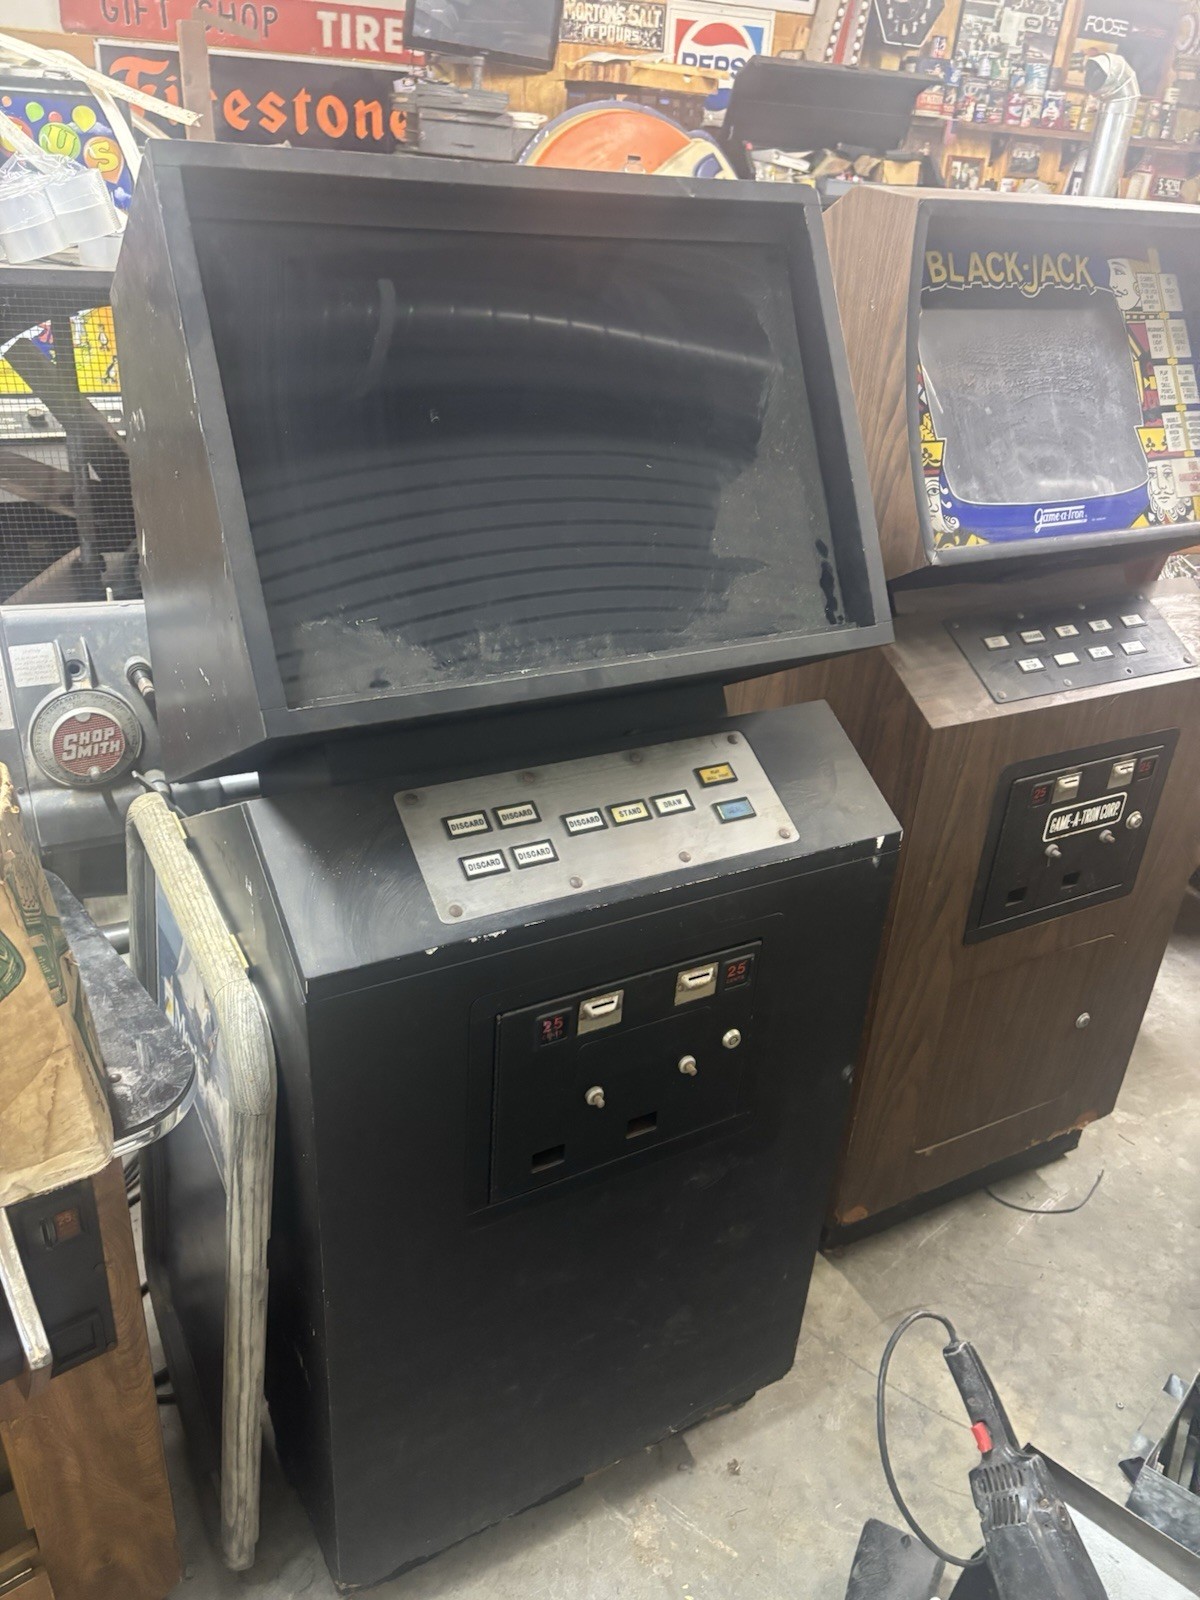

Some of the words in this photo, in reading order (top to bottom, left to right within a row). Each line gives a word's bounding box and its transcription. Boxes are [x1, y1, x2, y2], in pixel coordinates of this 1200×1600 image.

[316, 10, 424, 56] TIRE
[1084, 15, 1129, 37] FOOSE
[682, 52, 748, 80] PEPS
[109, 56, 407, 142] Fiestone
[663, 798, 683, 808] DRAW
[501, 808, 533, 821] DISCARD
[618, 806, 642, 818] STAND
[450, 818, 485, 832] DISCARD
[569, 815, 600, 828] DISCARD
[517, 847, 551, 861] DISCARD
[467, 858, 501, 872] DISCARD
[727, 960, 747, 979] 25
[542, 1015, 563, 1034] 25
